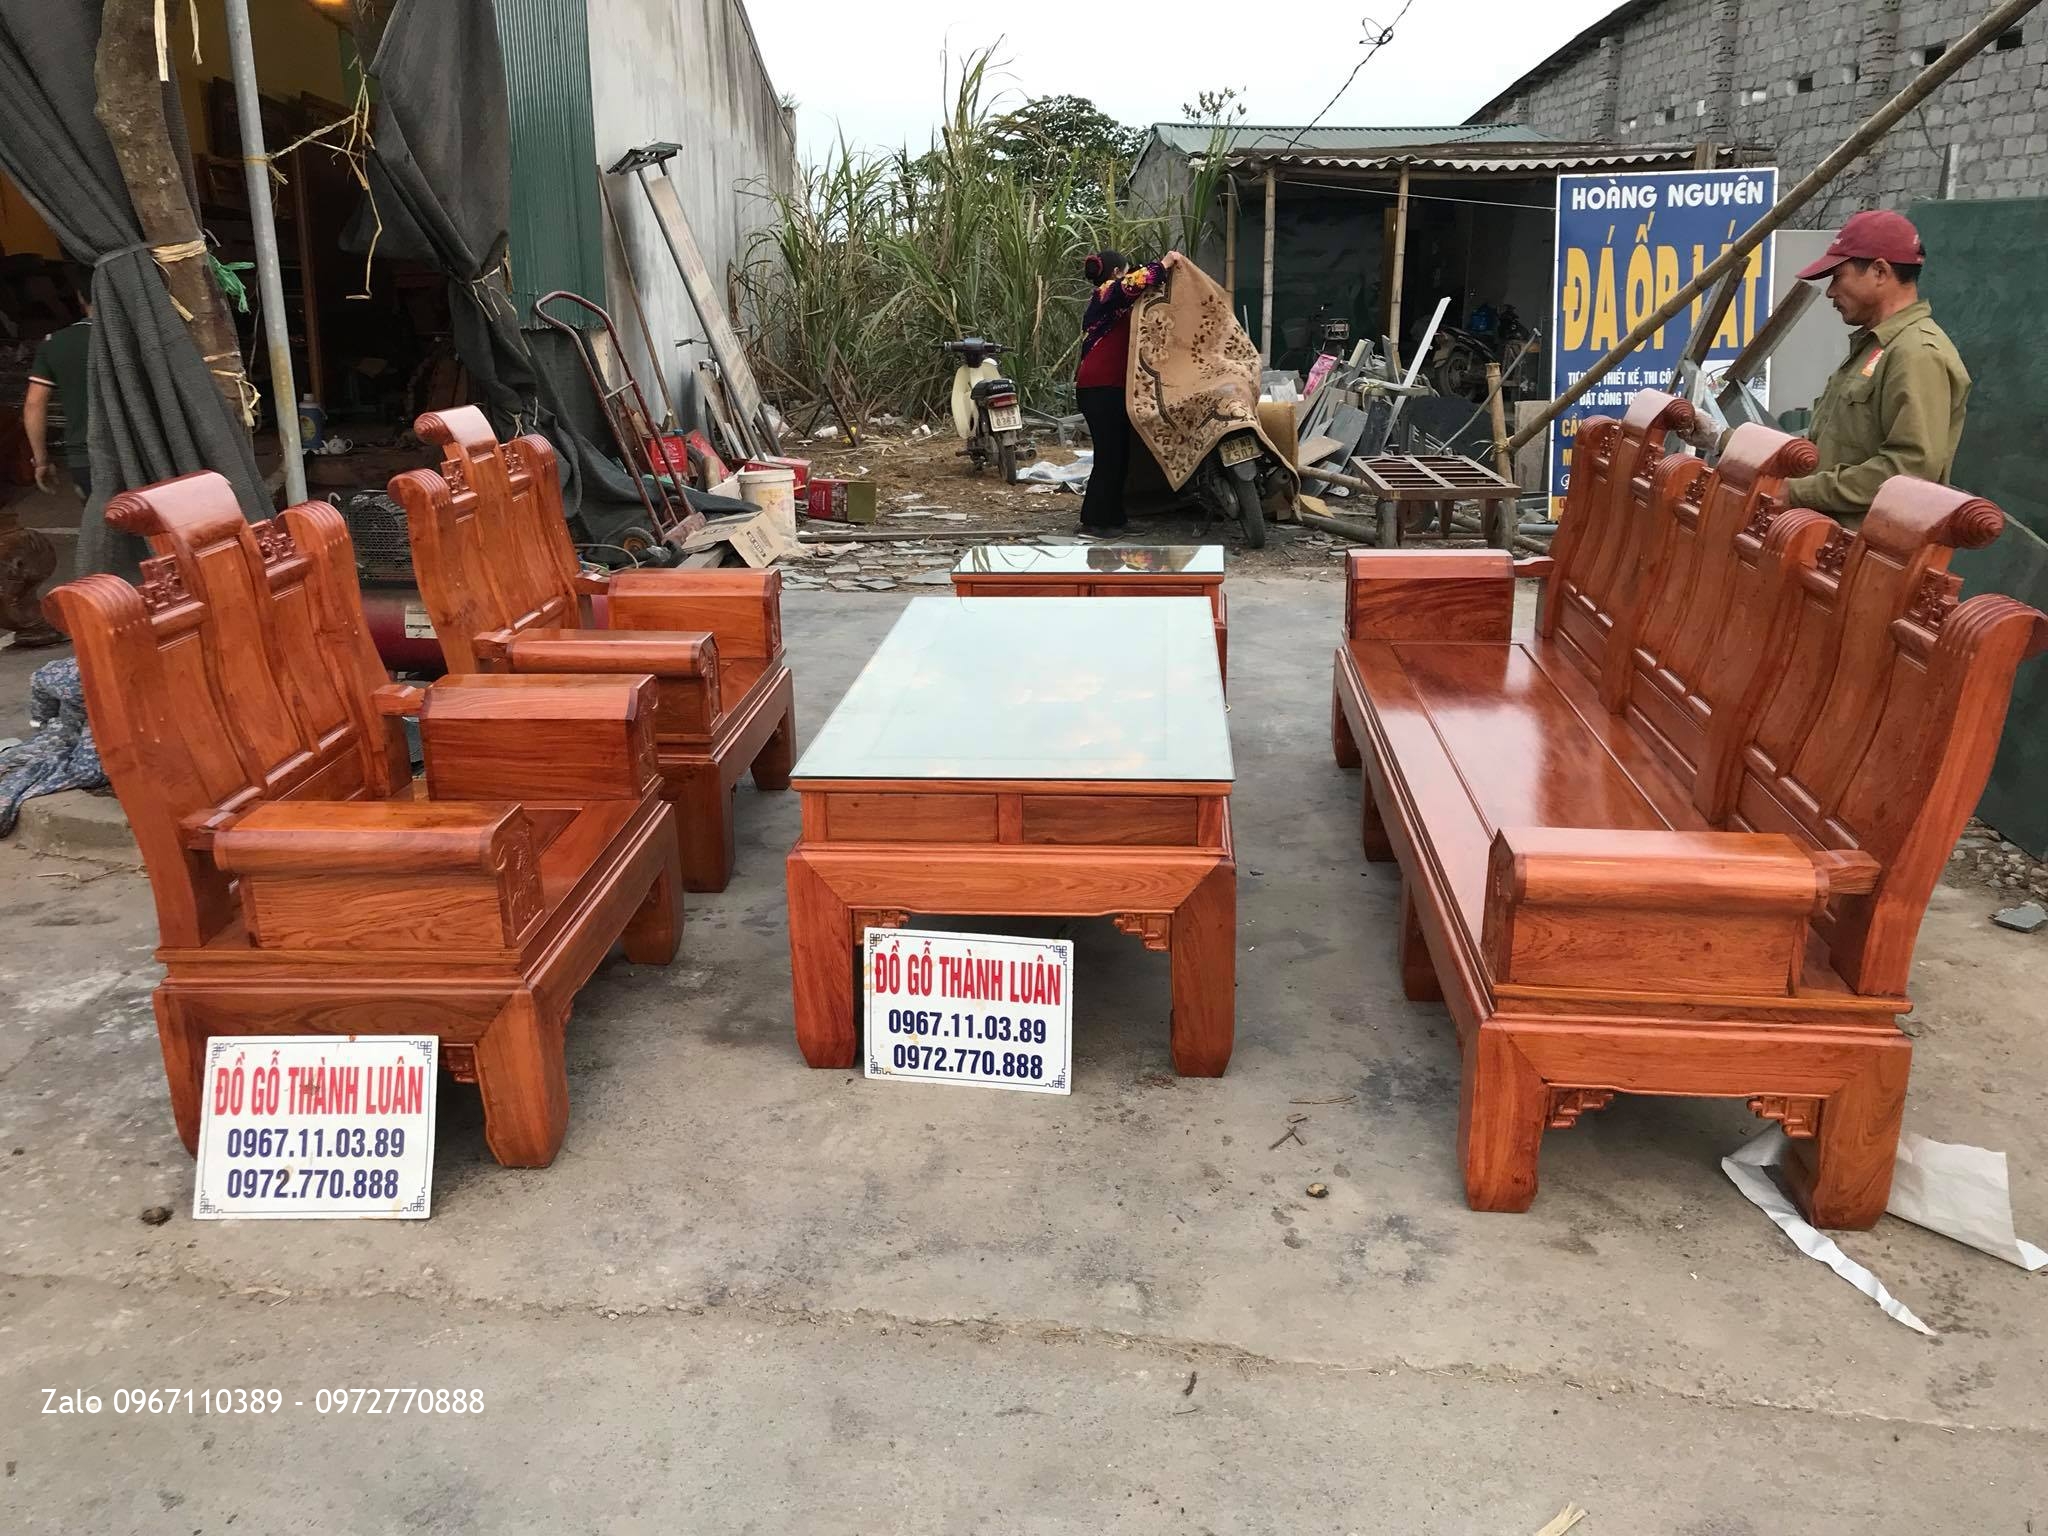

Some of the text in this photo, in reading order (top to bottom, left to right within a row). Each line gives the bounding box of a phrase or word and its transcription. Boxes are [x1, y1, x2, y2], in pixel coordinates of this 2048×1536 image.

[1572, 175, 1763, 210] HOÀNG NGUYÊN
[1563, 224, 1619, 351] ĐÁ
[1626, 211, 1679, 352] ỐP
[1644, 371, 1657, 385] THI
[1597, 389, 1622, 406] CÔNG
[874, 940, 1061, 1005] ĐỒ GỖ THÀNH LUÂN
[889, 1009, 1046, 1044] 0967.11.03.89
[893, 1044, 1043, 1080] 0972.770.888
[215, 1050, 424, 1116] ĐỒ GỖ THÀNH LUÂN
[227, 1128, 405, 1158] 0967.11.03.89
[227, 1168, 399, 1198] 0972.770.888
